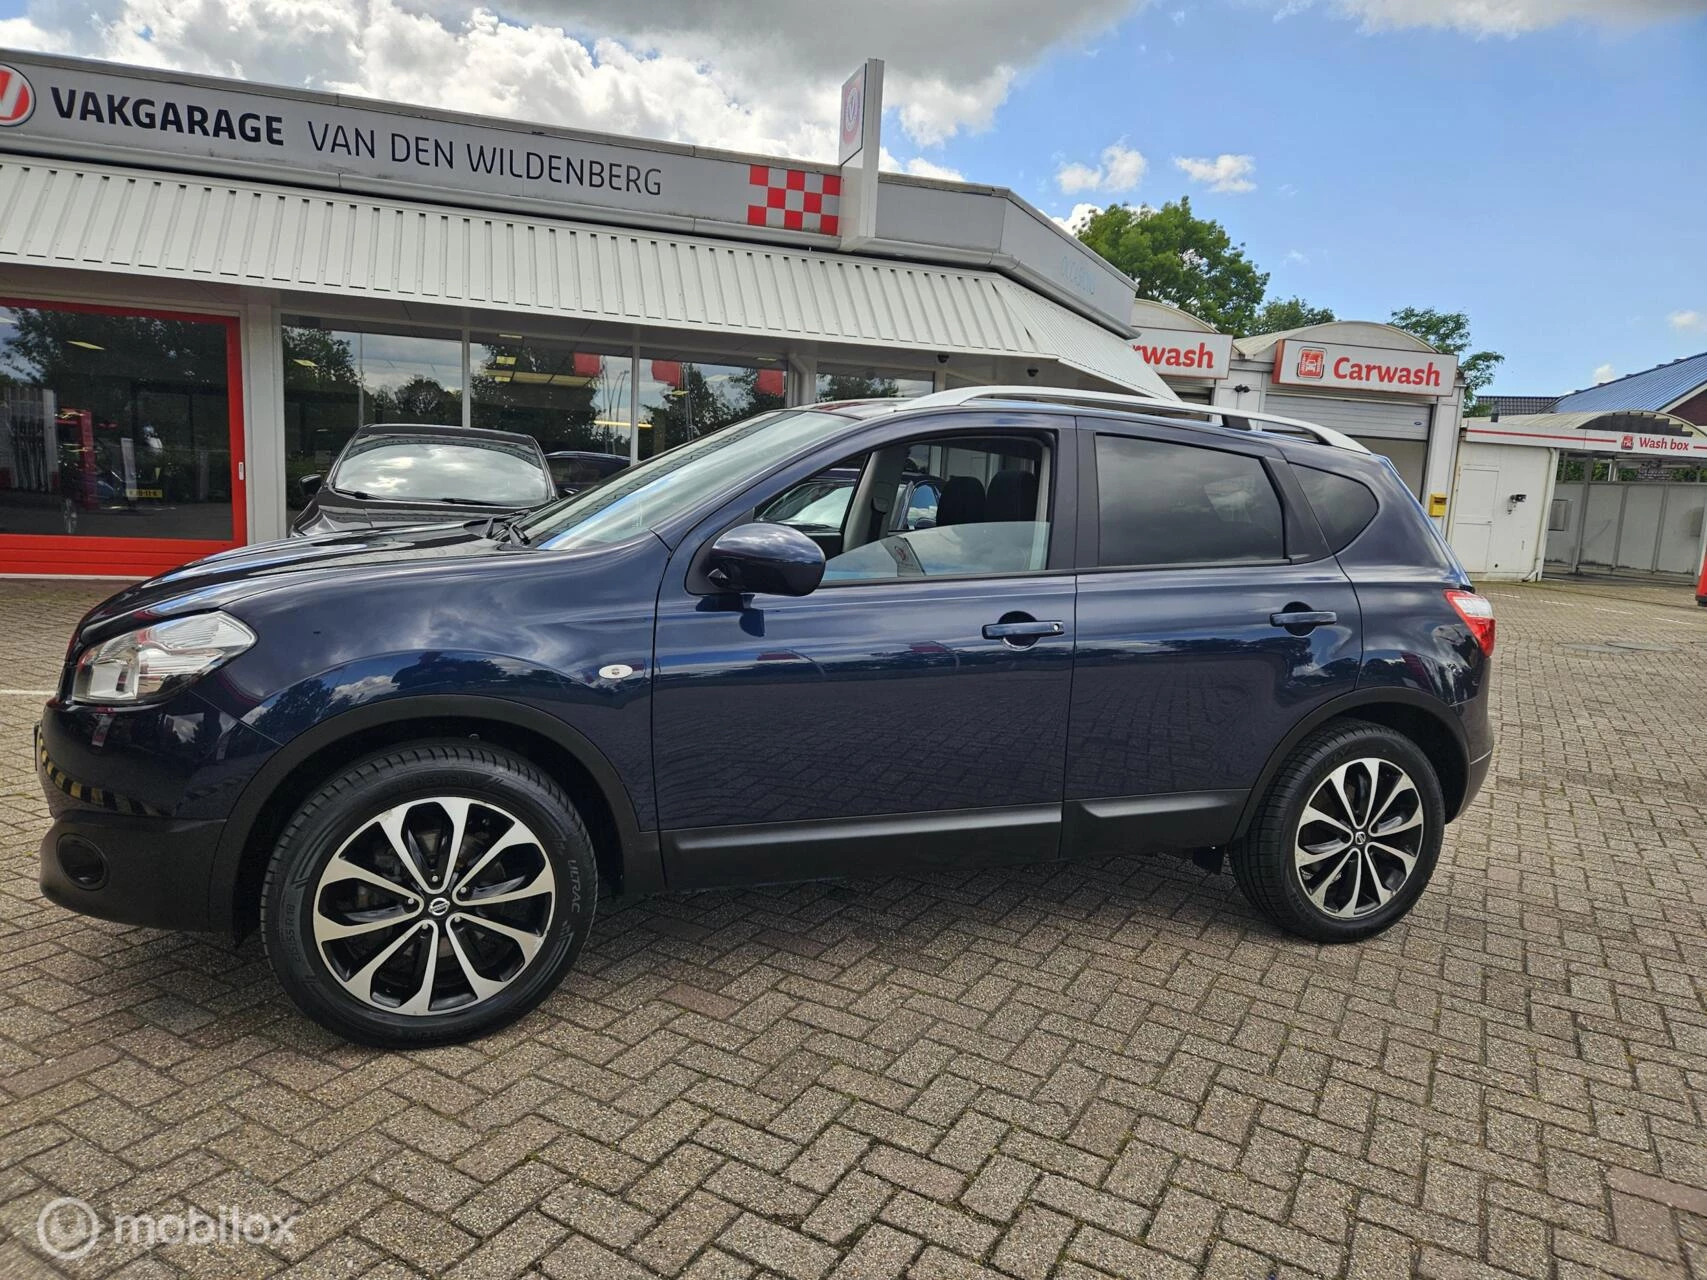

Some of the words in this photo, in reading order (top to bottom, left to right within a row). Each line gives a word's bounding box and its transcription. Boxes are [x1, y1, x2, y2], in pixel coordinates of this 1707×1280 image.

[50, 86, 285, 146] VAKGARAGE
[307, 120, 376, 159] VAN
[391, 132, 455, 169] DEN
[466, 143, 663, 196] WILDENBERG
[1333, 356, 1441, 387] Carwash
[1639, 436, 1668, 450] Wash
[1670, 438, 1690, 451] box
[567, 859, 581, 913] ULTRAC
